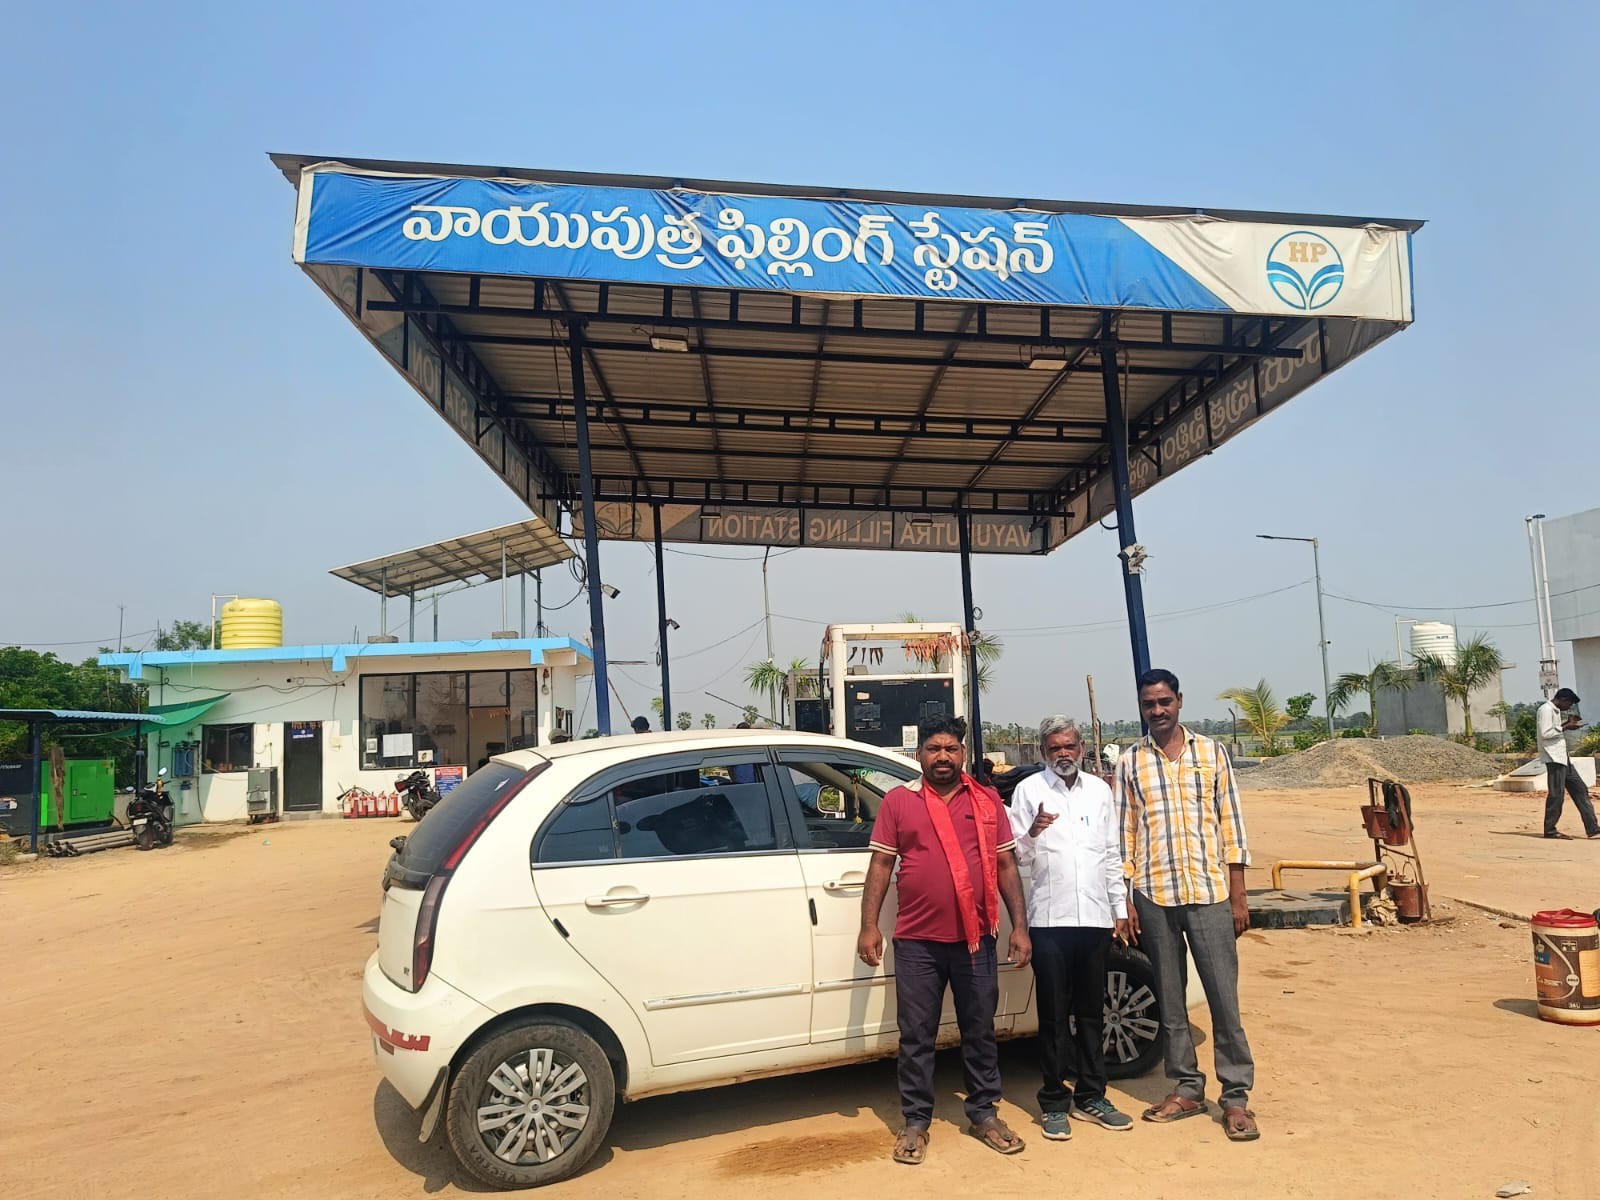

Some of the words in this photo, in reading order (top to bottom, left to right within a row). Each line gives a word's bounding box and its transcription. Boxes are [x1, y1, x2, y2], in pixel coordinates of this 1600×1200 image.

[402, 202, 705, 269] వాయుపుత్ర
[716, 207, 895, 277] ఫిల్లింగ్
[908, 211, 1054, 291] స్టేషన్
[1288, 241, 1328, 263] HP
